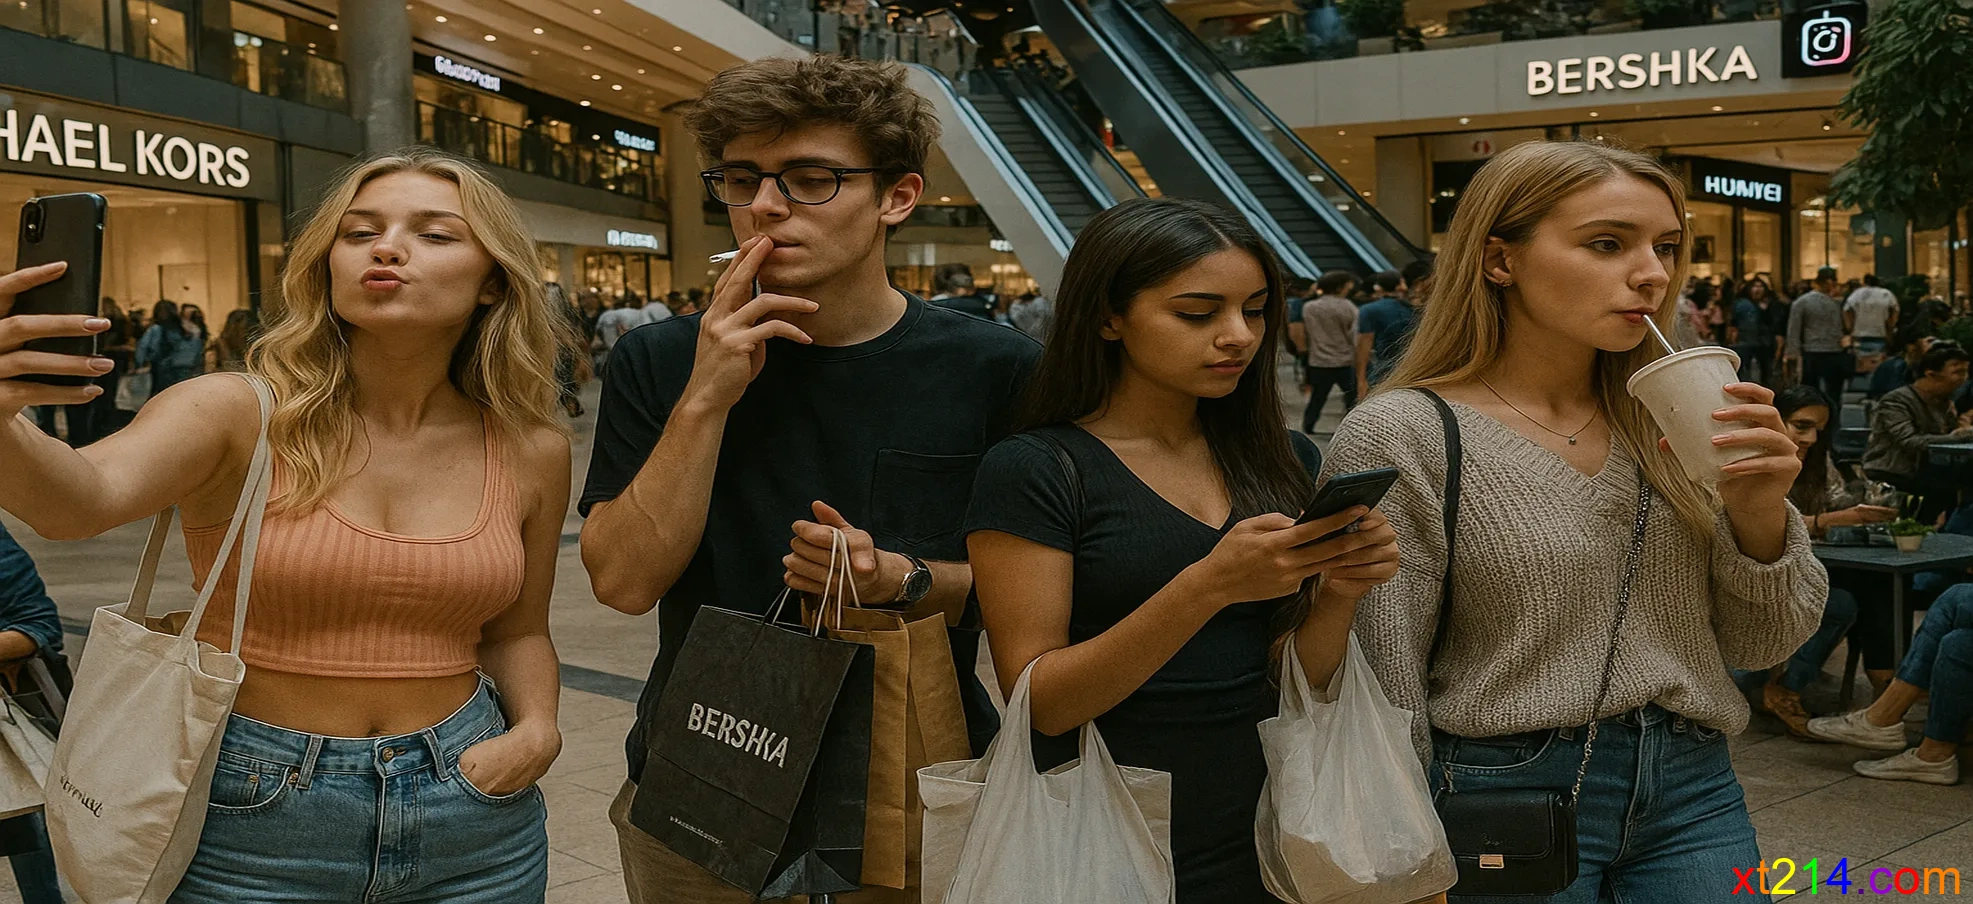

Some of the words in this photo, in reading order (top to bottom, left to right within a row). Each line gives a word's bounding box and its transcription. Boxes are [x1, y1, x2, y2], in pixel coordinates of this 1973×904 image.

[1527, 45, 1758, 96] BERSHKA
[136, 129, 251, 188] KORS
[687, 702, 789, 768] BERSHKA
